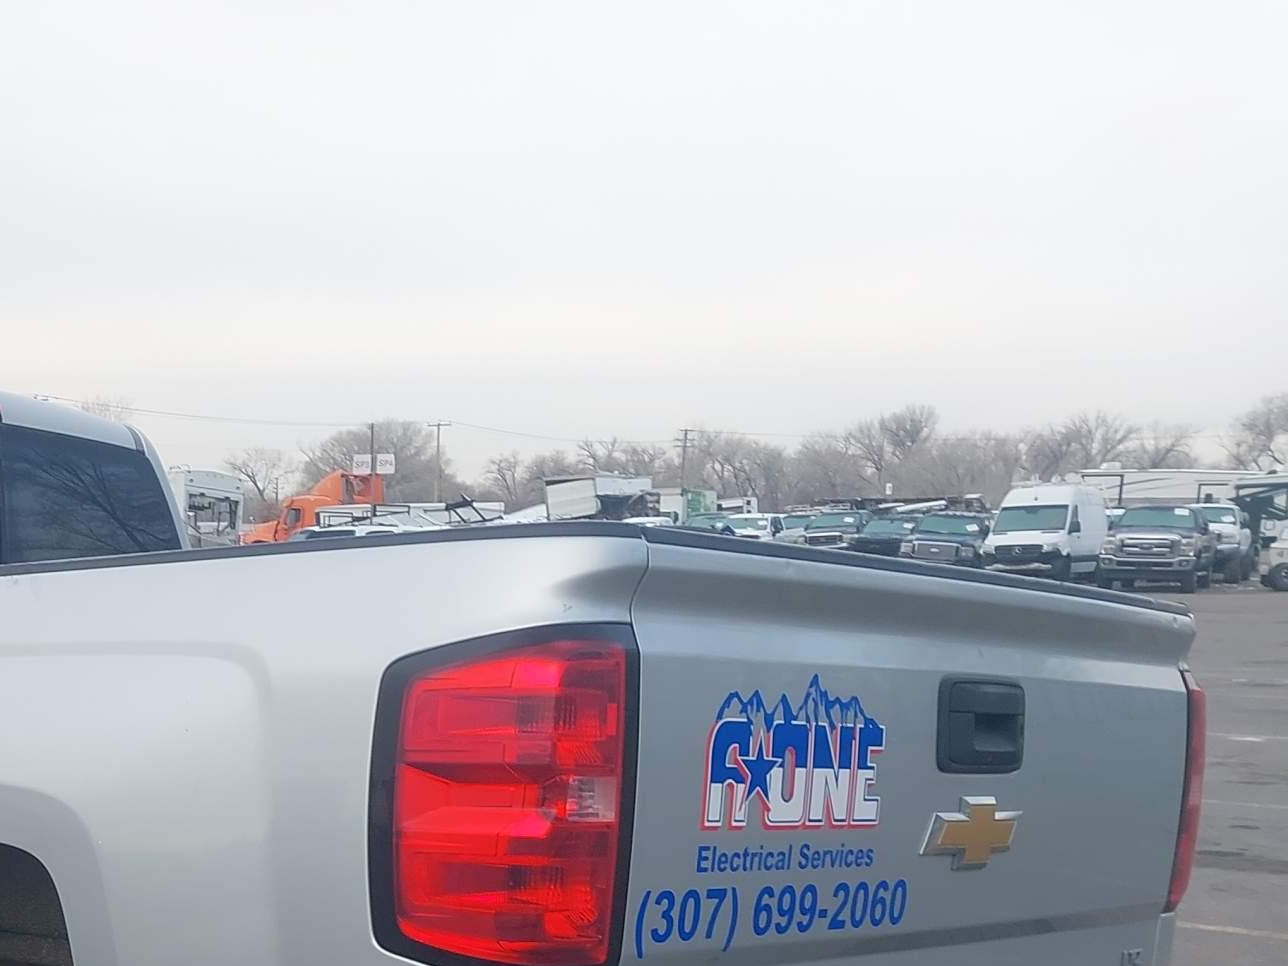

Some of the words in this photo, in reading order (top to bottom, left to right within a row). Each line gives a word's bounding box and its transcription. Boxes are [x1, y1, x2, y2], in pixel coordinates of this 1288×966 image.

[695, 845, 792, 873] Electrical
[797, 843, 874, 869] Services
[634, 886, 739, 960] (307)
[751, 879, 908, 937] 699-2060
